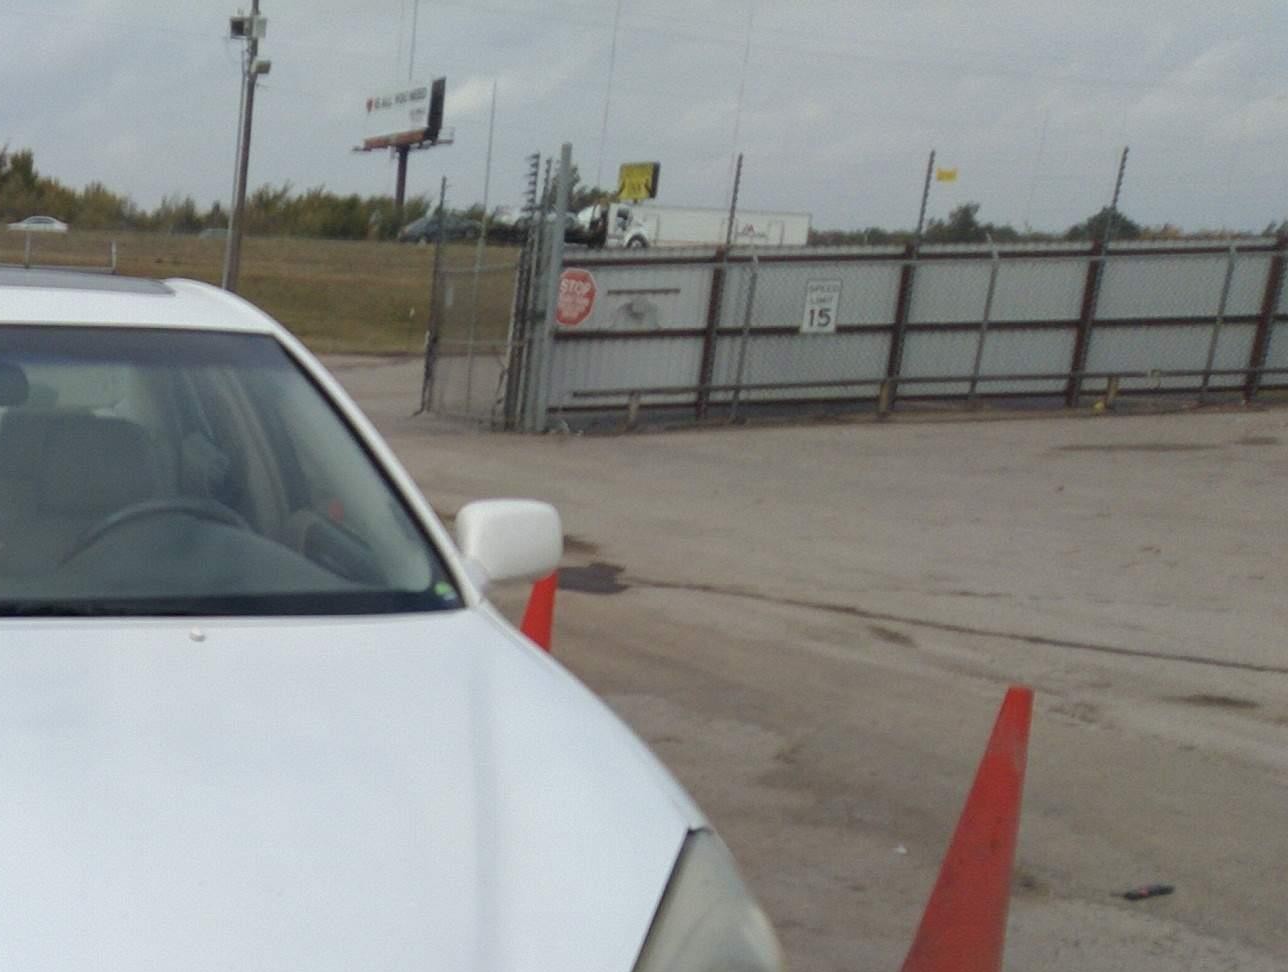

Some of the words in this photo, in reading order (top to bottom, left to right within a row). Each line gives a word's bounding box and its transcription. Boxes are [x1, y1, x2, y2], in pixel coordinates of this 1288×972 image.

[560, 279, 591, 294] STOP
[808, 283, 841, 293] SPEED
[809, 307, 832, 328] 15
